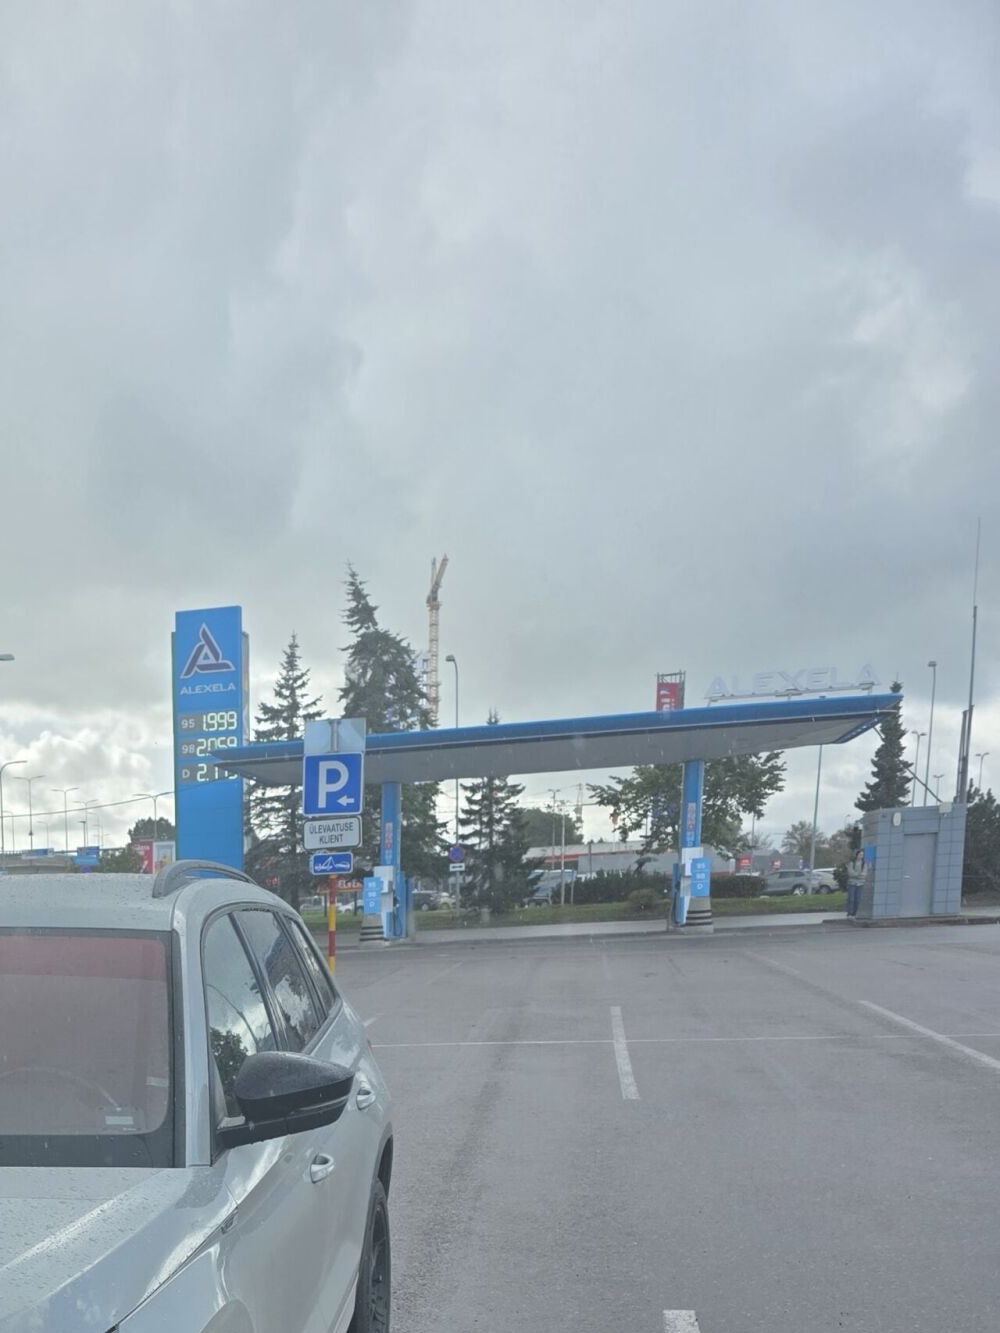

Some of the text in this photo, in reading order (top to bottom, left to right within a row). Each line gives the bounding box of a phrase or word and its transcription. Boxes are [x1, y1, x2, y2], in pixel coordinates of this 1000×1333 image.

[703, 664, 880, 699] ALEXELA
[180, 682, 236, 695] ALEXELA
[181, 719, 195, 729] 95
[182, 744, 195, 754] 98
[182, 769, 190, 778] D
[318, 761, 349, 808] P
[309, 822, 354, 834] ÜLEVAATUSE
[319, 834, 344, 844] KLIENT
